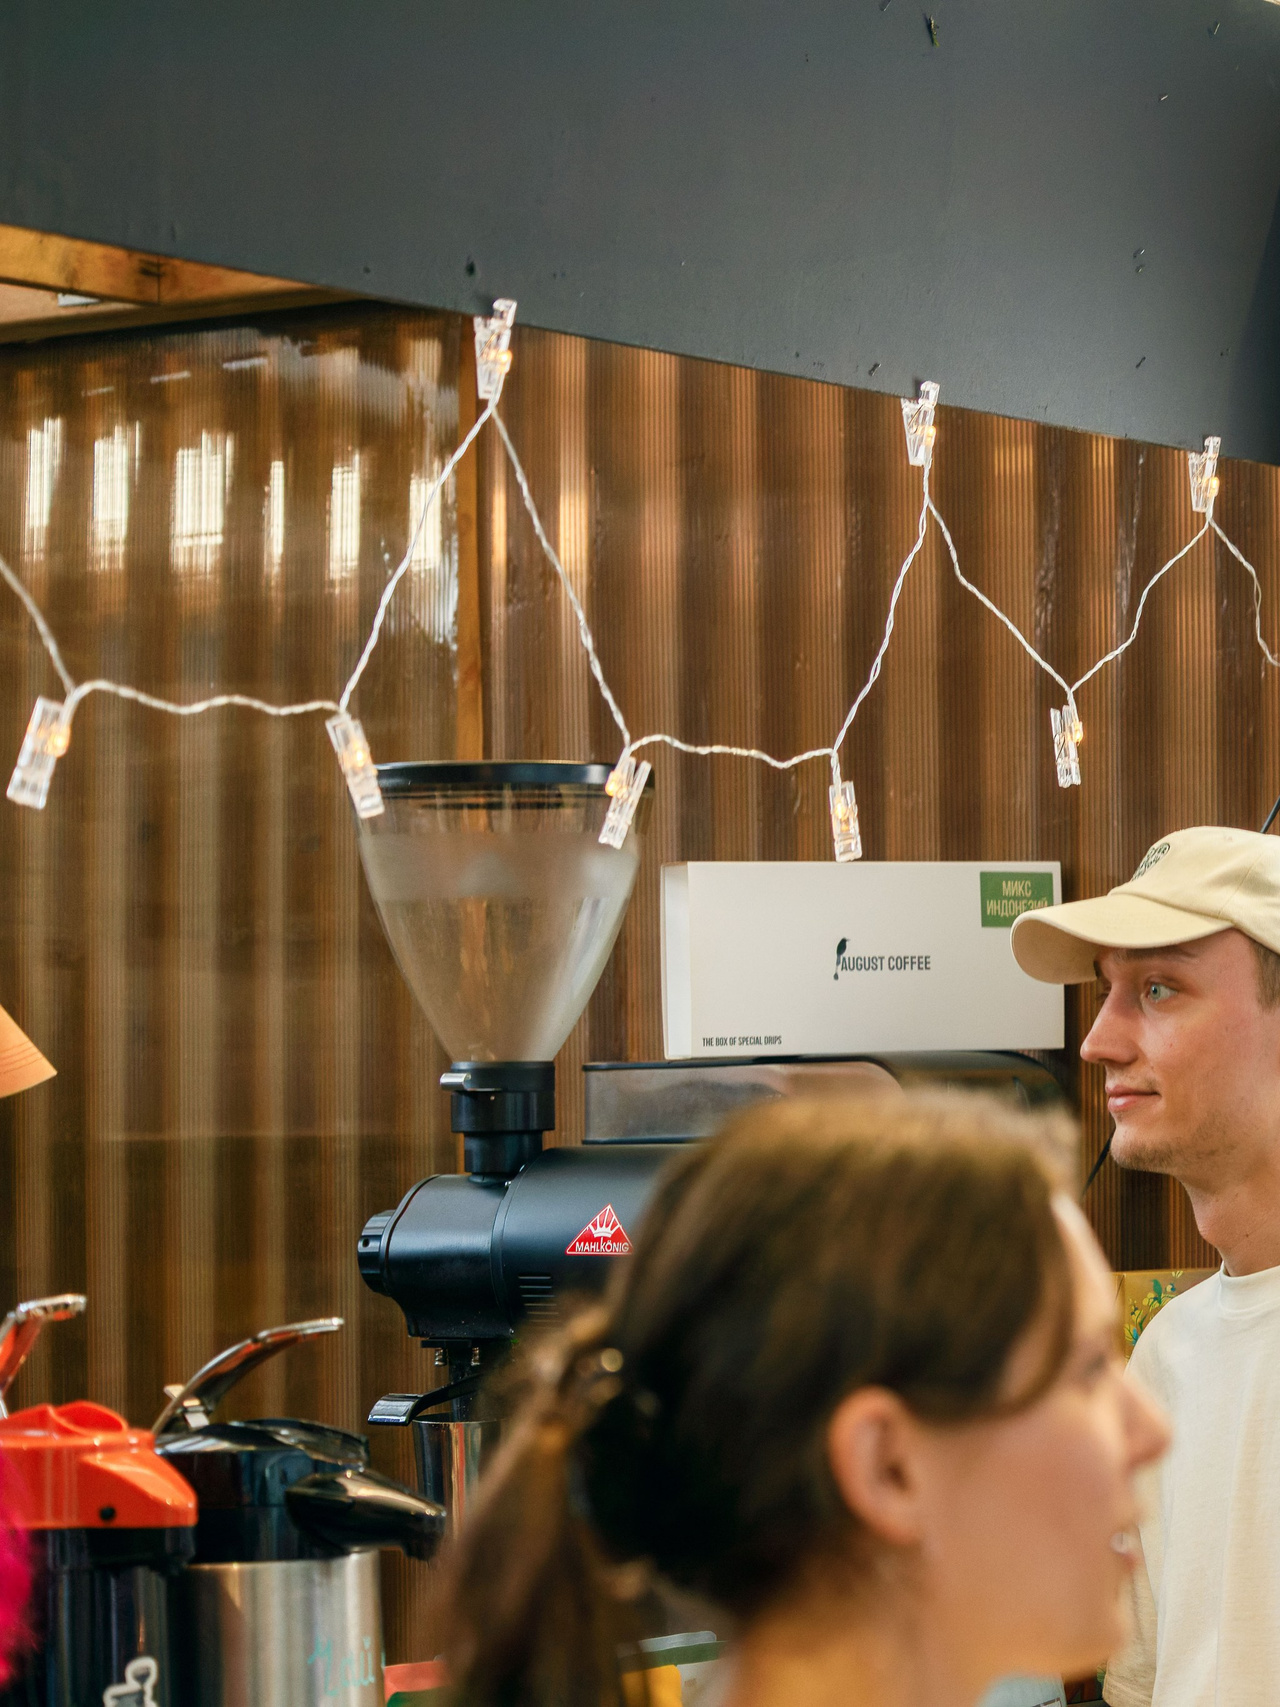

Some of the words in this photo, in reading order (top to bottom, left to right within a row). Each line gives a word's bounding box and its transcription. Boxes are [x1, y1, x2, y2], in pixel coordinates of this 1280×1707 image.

[1002, 880, 1032, 898] МИКС
[841, 955, 885, 972] AUGUST
[887, 955, 931, 971] COFFEE
[702, 1037, 714, 1047] THE
[715, 1036, 728, 1047] BOX
[729, 1036, 737, 1046] OF
[738, 1035, 762, 1046] SPECIAL
[764, 1035, 782, 1046] DRIPS
